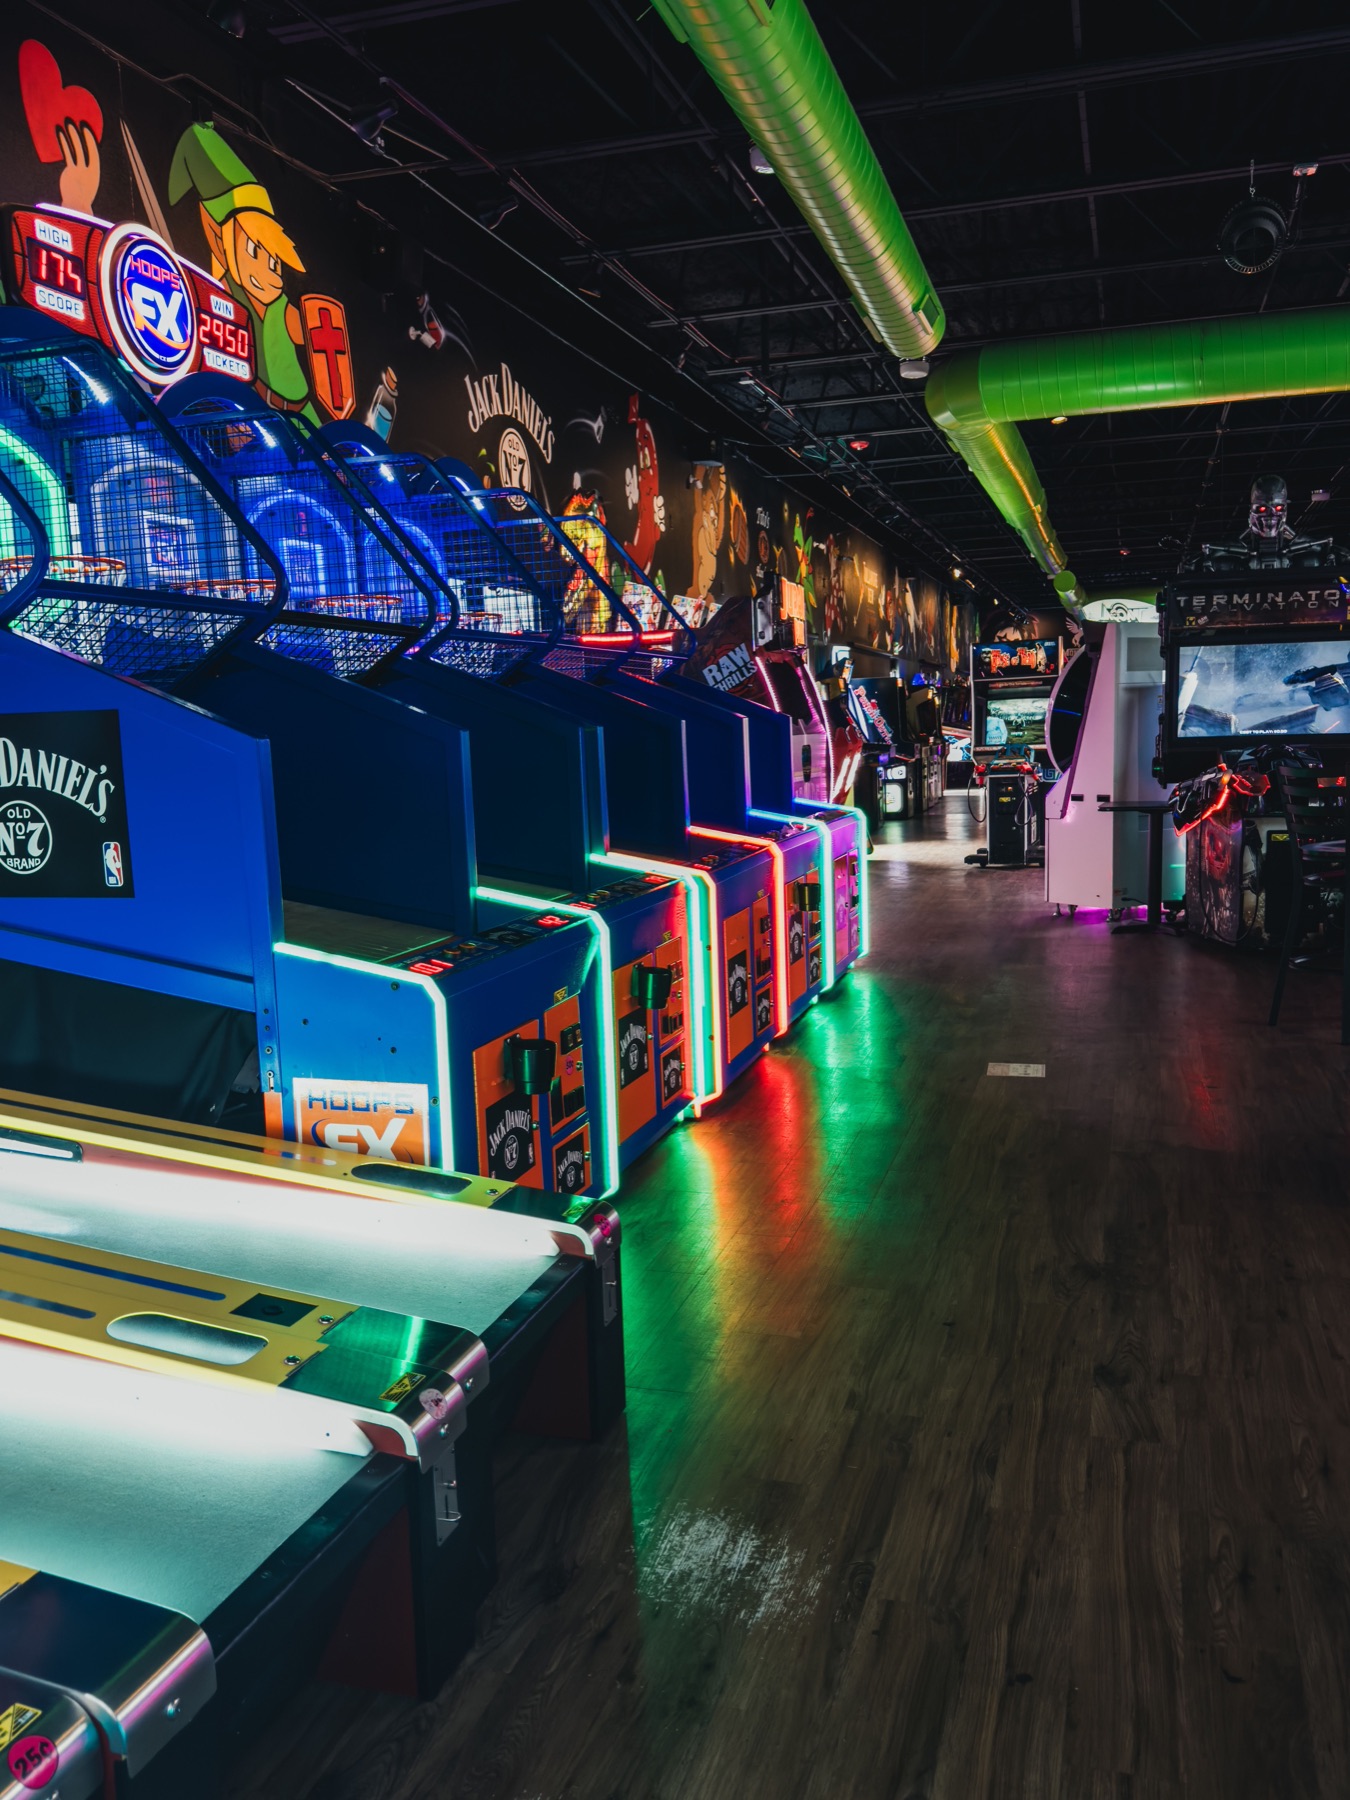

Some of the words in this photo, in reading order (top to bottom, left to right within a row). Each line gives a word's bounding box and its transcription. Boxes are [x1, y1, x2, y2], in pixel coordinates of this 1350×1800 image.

[38, 224, 69, 246] HIGH
[129, 254, 181, 290] HOOPS
[38, 289, 81, 316] SCORE
[212, 300, 232, 317] WIN
[199, 313, 249, 358] 2950
[206, 351, 248, 377] TICKETS
[464, 374, 503, 433] JACK
[500, 362, 555, 464] DANIEL'S
[1176, 590, 1350, 607] TERMINATO
[702, 643, 751, 687] RAW
[0, 737, 115, 817] DANIEL'S
[7, 806, 31, 819] OLD
[6, 857, 41, 870] BRAND
[308, 1087, 414, 1114] HOOPS
[489, 1118, 508, 1157] JACK
